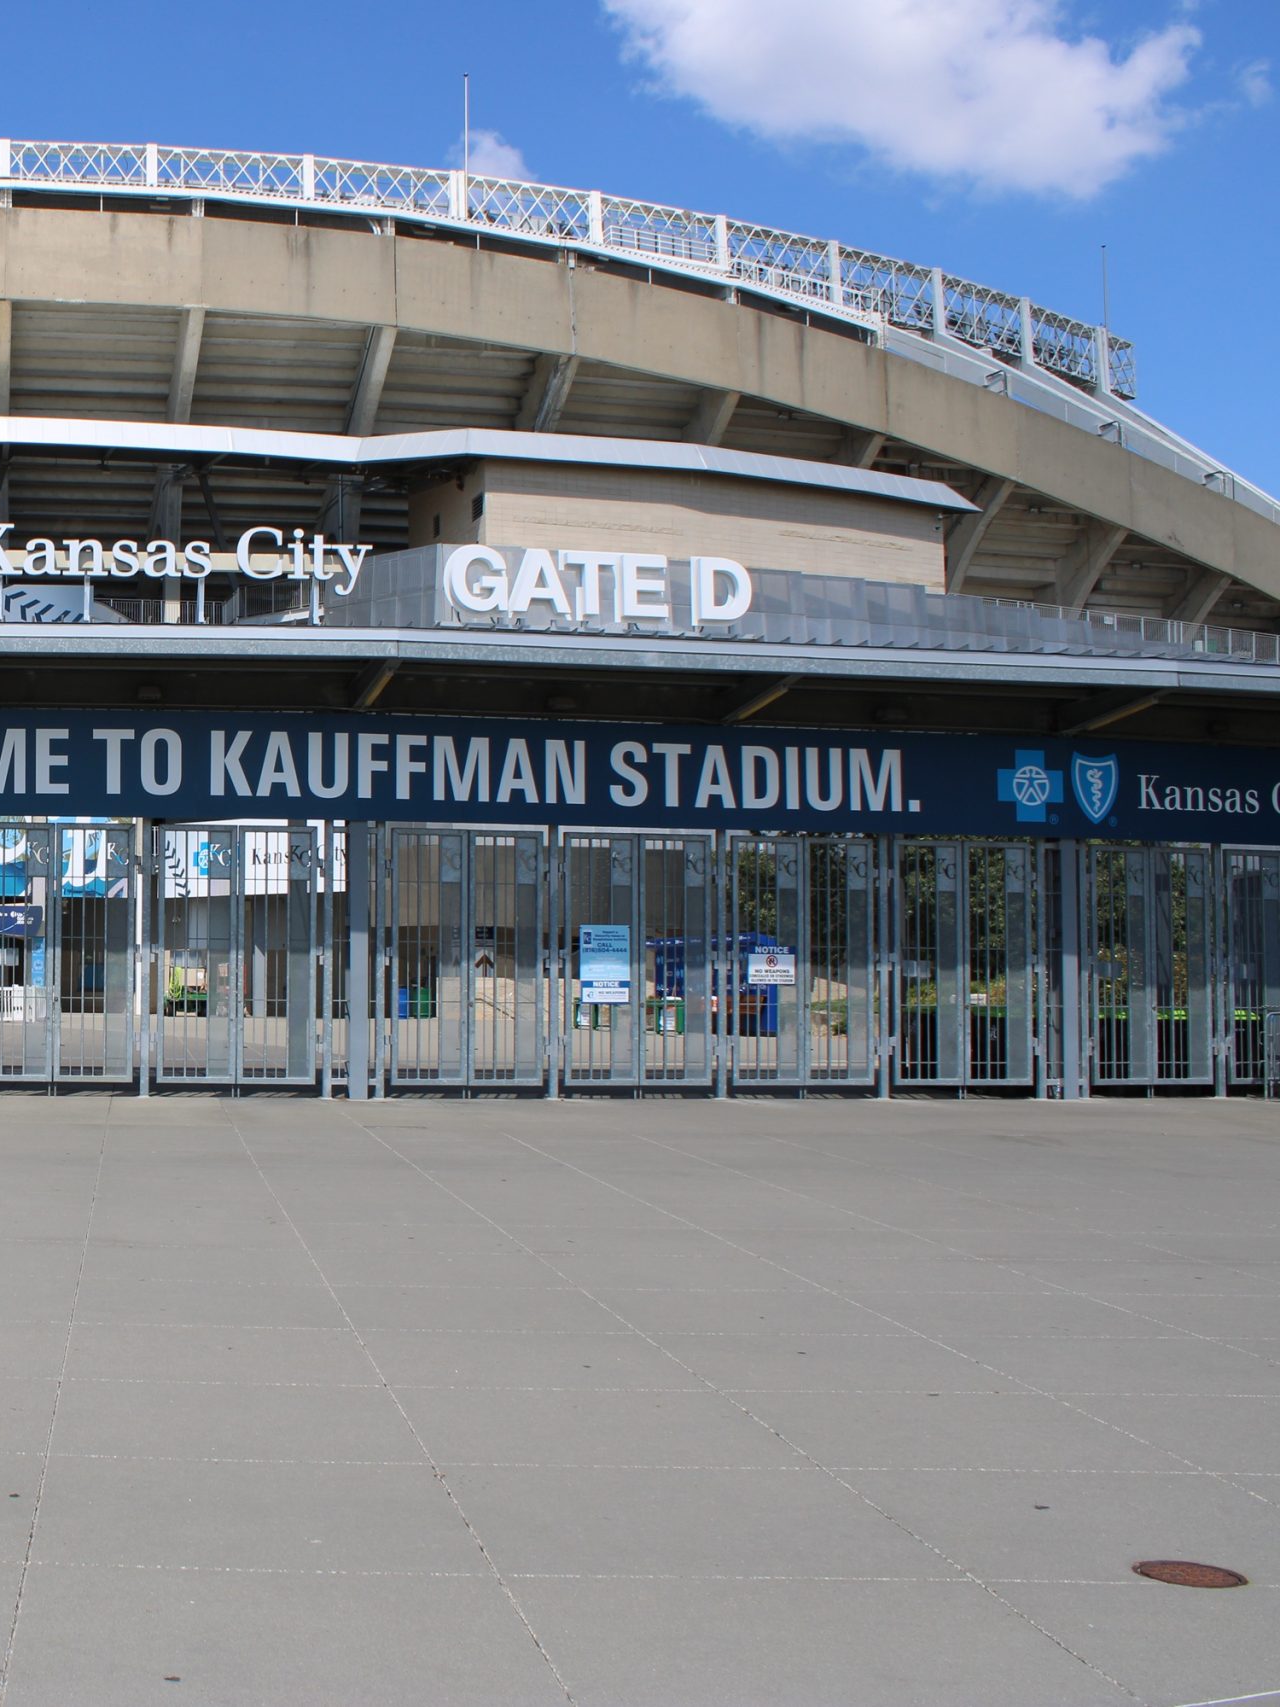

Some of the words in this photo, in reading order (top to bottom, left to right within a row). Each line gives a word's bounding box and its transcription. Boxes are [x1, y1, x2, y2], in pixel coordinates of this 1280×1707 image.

[237, 526, 373, 596] City
[443, 544, 669, 623] GATE
[690, 556, 752, 626] D
[92, 728, 183, 796] TO
[210, 731, 586, 805] KAUFFMAN
[609, 741, 920, 812] STADIUM.
[1137, 774, 1260, 814] Kansas
[315, 845, 346, 867] Cty
[754, 946, 790, 954] NOTICE
